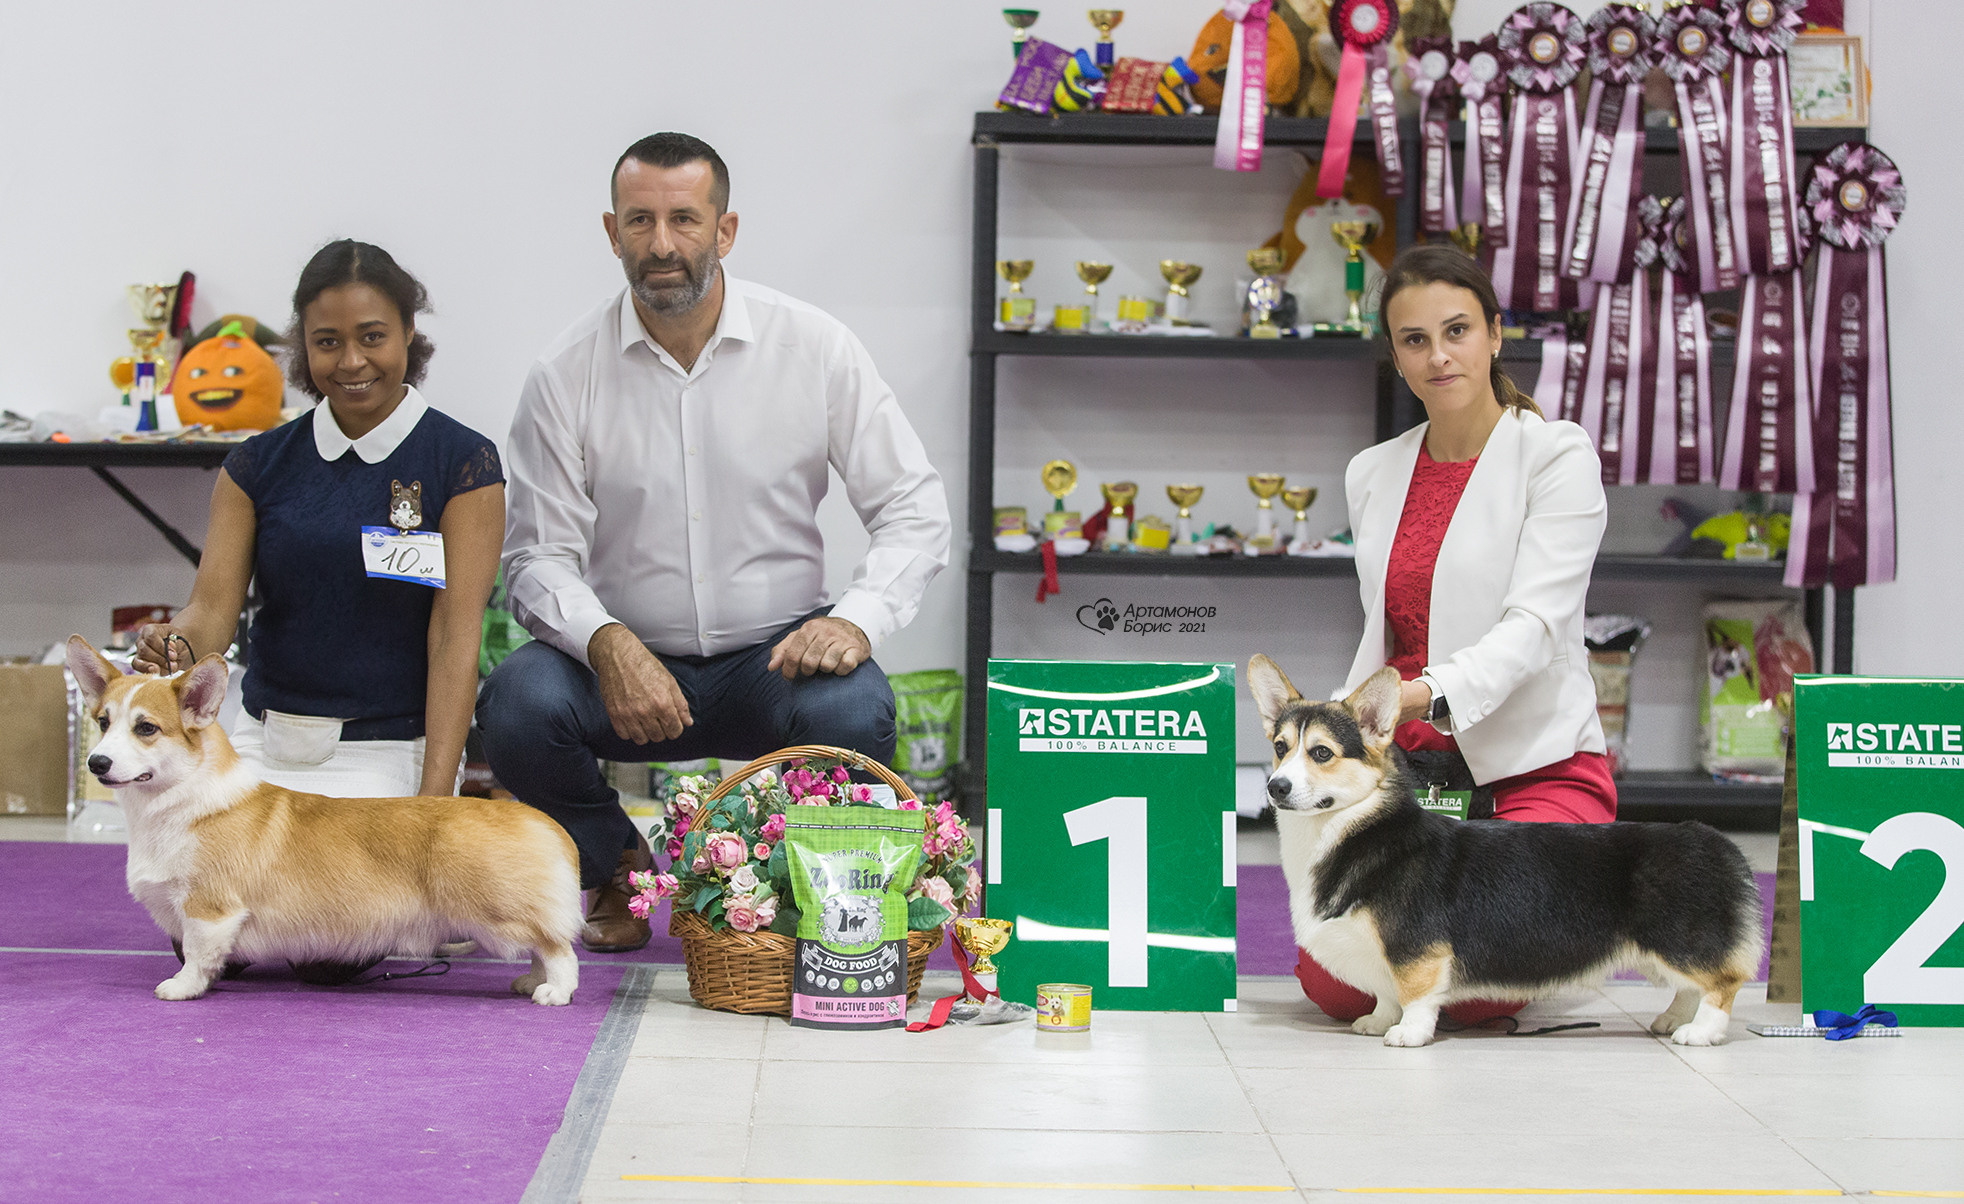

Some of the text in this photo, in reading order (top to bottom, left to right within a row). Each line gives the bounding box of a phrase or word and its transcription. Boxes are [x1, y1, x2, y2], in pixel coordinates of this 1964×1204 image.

[1758, 380, 1779, 473] WINNER
[381, 546, 421, 573] 10
[1048, 708, 1207, 737] STATERA
[1048, 740, 1177, 752] 100% BALANCE
[1857, 755, 1896, 766] 100%
[1417, 797, 1463, 807] STATERA
[823, 849, 883, 864] SUPER PREMIUM
[1062, 796, 1148, 988] 1
[1859, 811, 1964, 1004] 2
[824, 956, 878, 970] DOG FOOD
[815, 1001, 885, 1012] MINI ACTIVE DOG
